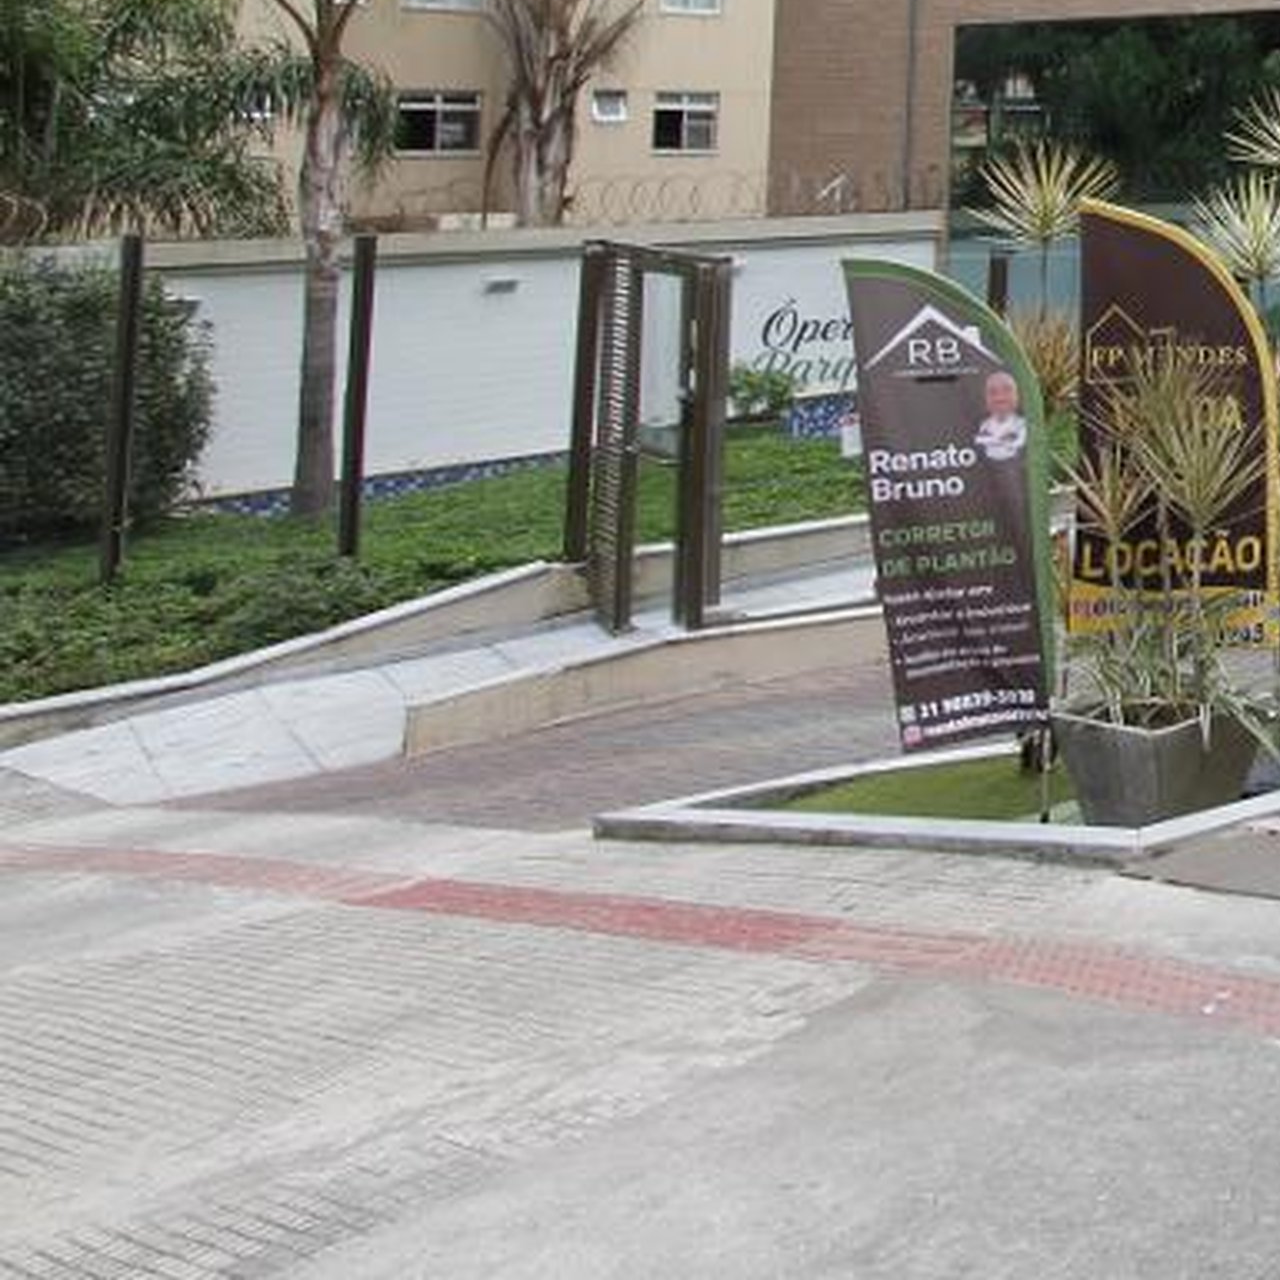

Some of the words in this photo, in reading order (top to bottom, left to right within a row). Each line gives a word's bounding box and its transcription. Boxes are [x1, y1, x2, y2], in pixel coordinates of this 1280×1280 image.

[761, 297, 853, 352] Óper
[907, 335, 962, 365] RB
[869, 443, 977, 475] Renato
[872, 472, 965, 503] Bruno
[879, 521, 995, 548] CORRETOR
[916, 546, 1016, 572] PLANTÃO
[1082, 531, 1262, 585] LOCAÇÃO
